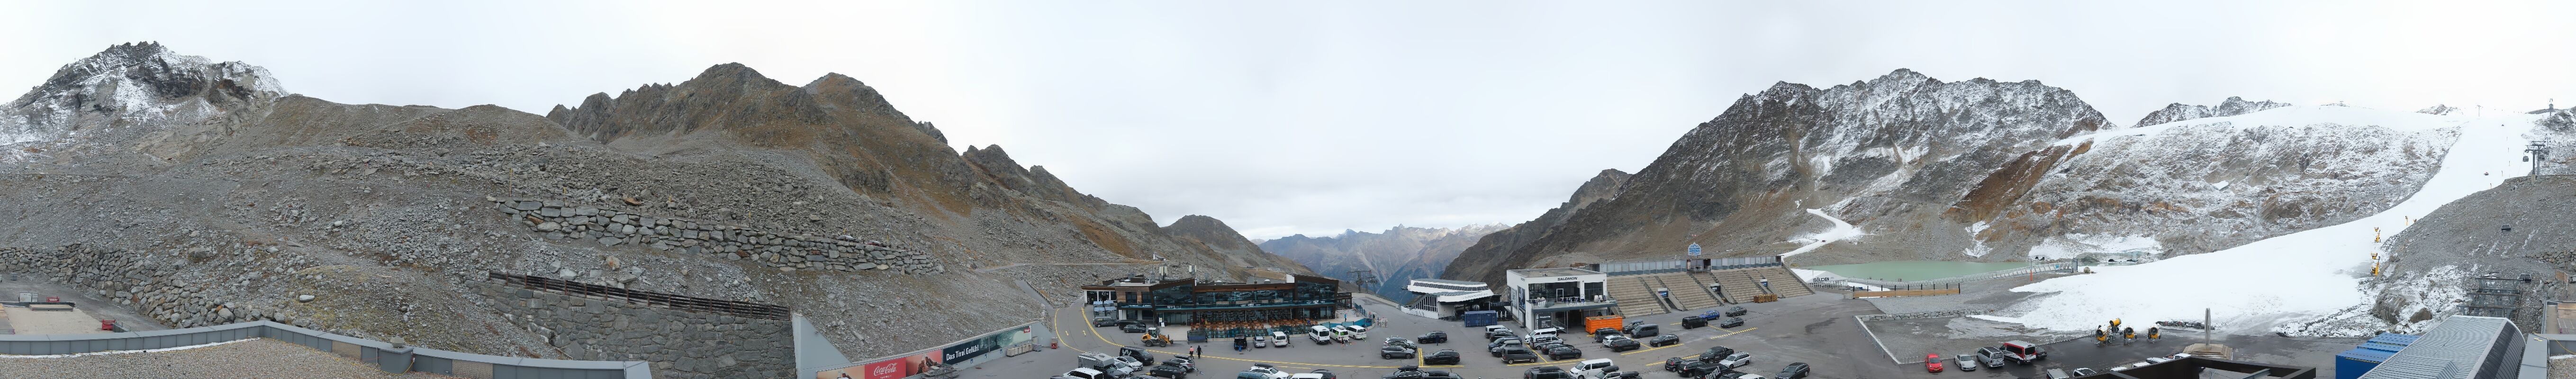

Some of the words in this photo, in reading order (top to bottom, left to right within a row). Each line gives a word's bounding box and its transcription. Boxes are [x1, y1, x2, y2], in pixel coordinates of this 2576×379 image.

[955, 348, 966, 358] Tirol
[966, 344, 979, 354] Gefühl
[874, 362, 898, 376] Coca-Cola
